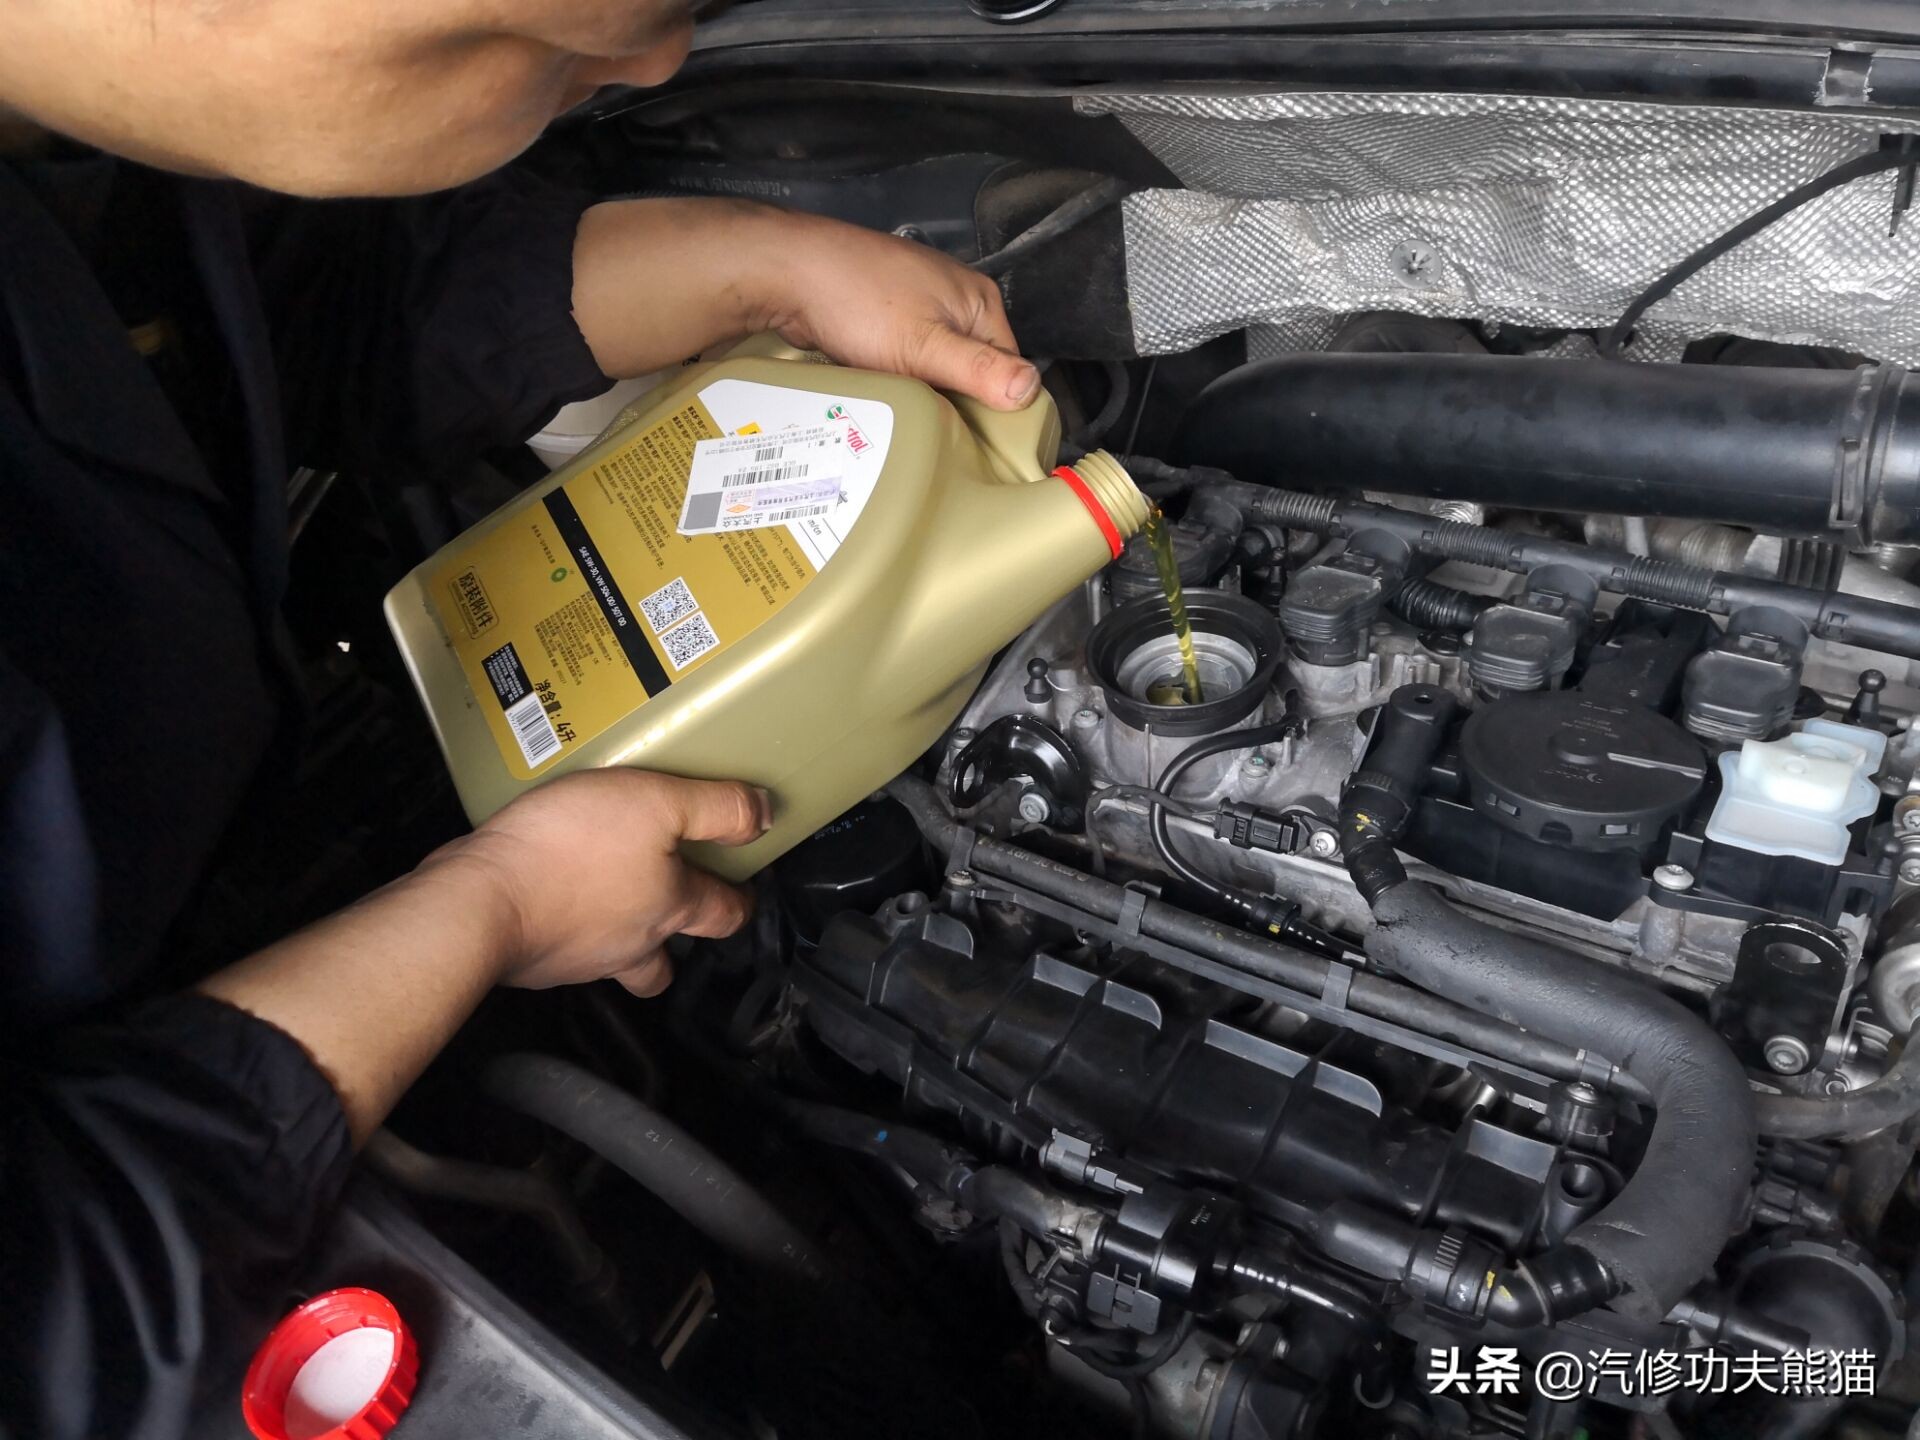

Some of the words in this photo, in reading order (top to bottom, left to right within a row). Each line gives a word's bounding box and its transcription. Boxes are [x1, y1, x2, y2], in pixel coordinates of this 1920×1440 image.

[722, 517, 761, 528] 上汽大众
[578, 546, 589, 557] SAE
[583, 557, 599, 577] 5W-30,
[595, 576, 604, 586] VW
[600, 586, 610, 597] 504
[459, 572, 493, 628] 原装附件
[611, 606, 622, 617] 507
[617, 616, 626, 626] 00
